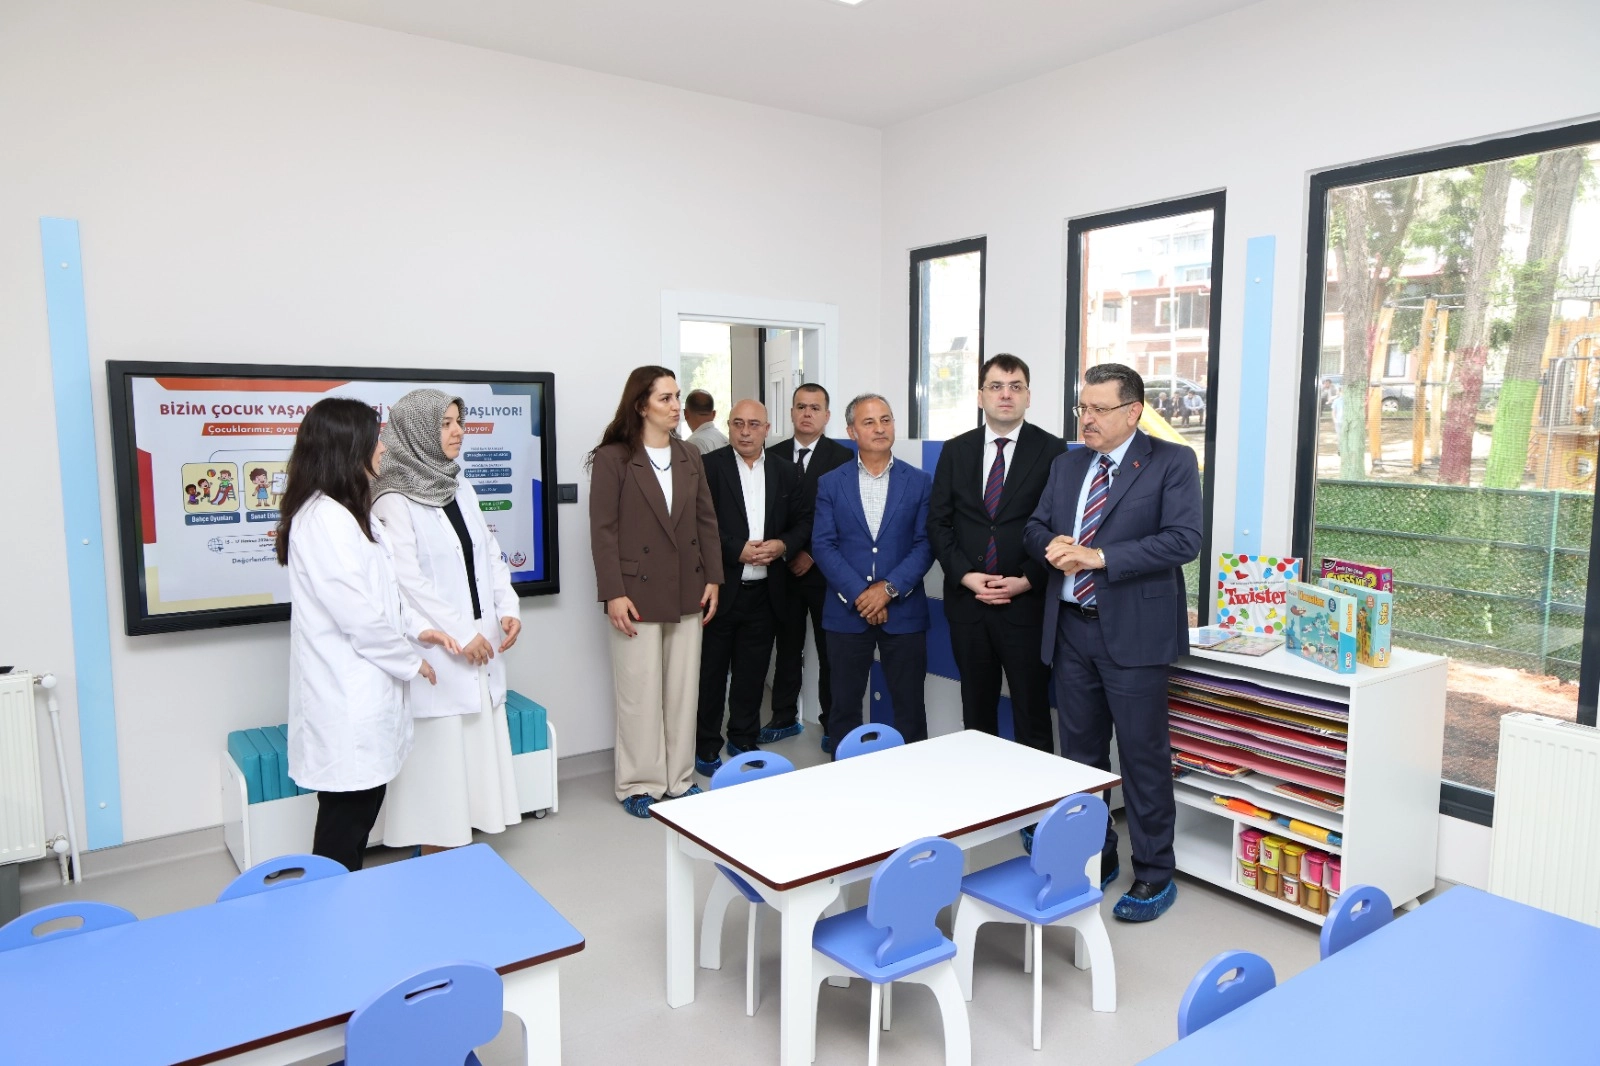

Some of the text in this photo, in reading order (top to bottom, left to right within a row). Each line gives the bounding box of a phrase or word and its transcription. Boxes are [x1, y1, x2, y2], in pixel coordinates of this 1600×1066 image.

[160, 401, 206, 415] BİZİM
[211, 404, 264, 418] ÇOCUK
[208, 425, 273, 434] Çocuklarımız;
[191, 515, 208, 523] Bahçe
[1225, 588, 1287, 605] Twister
